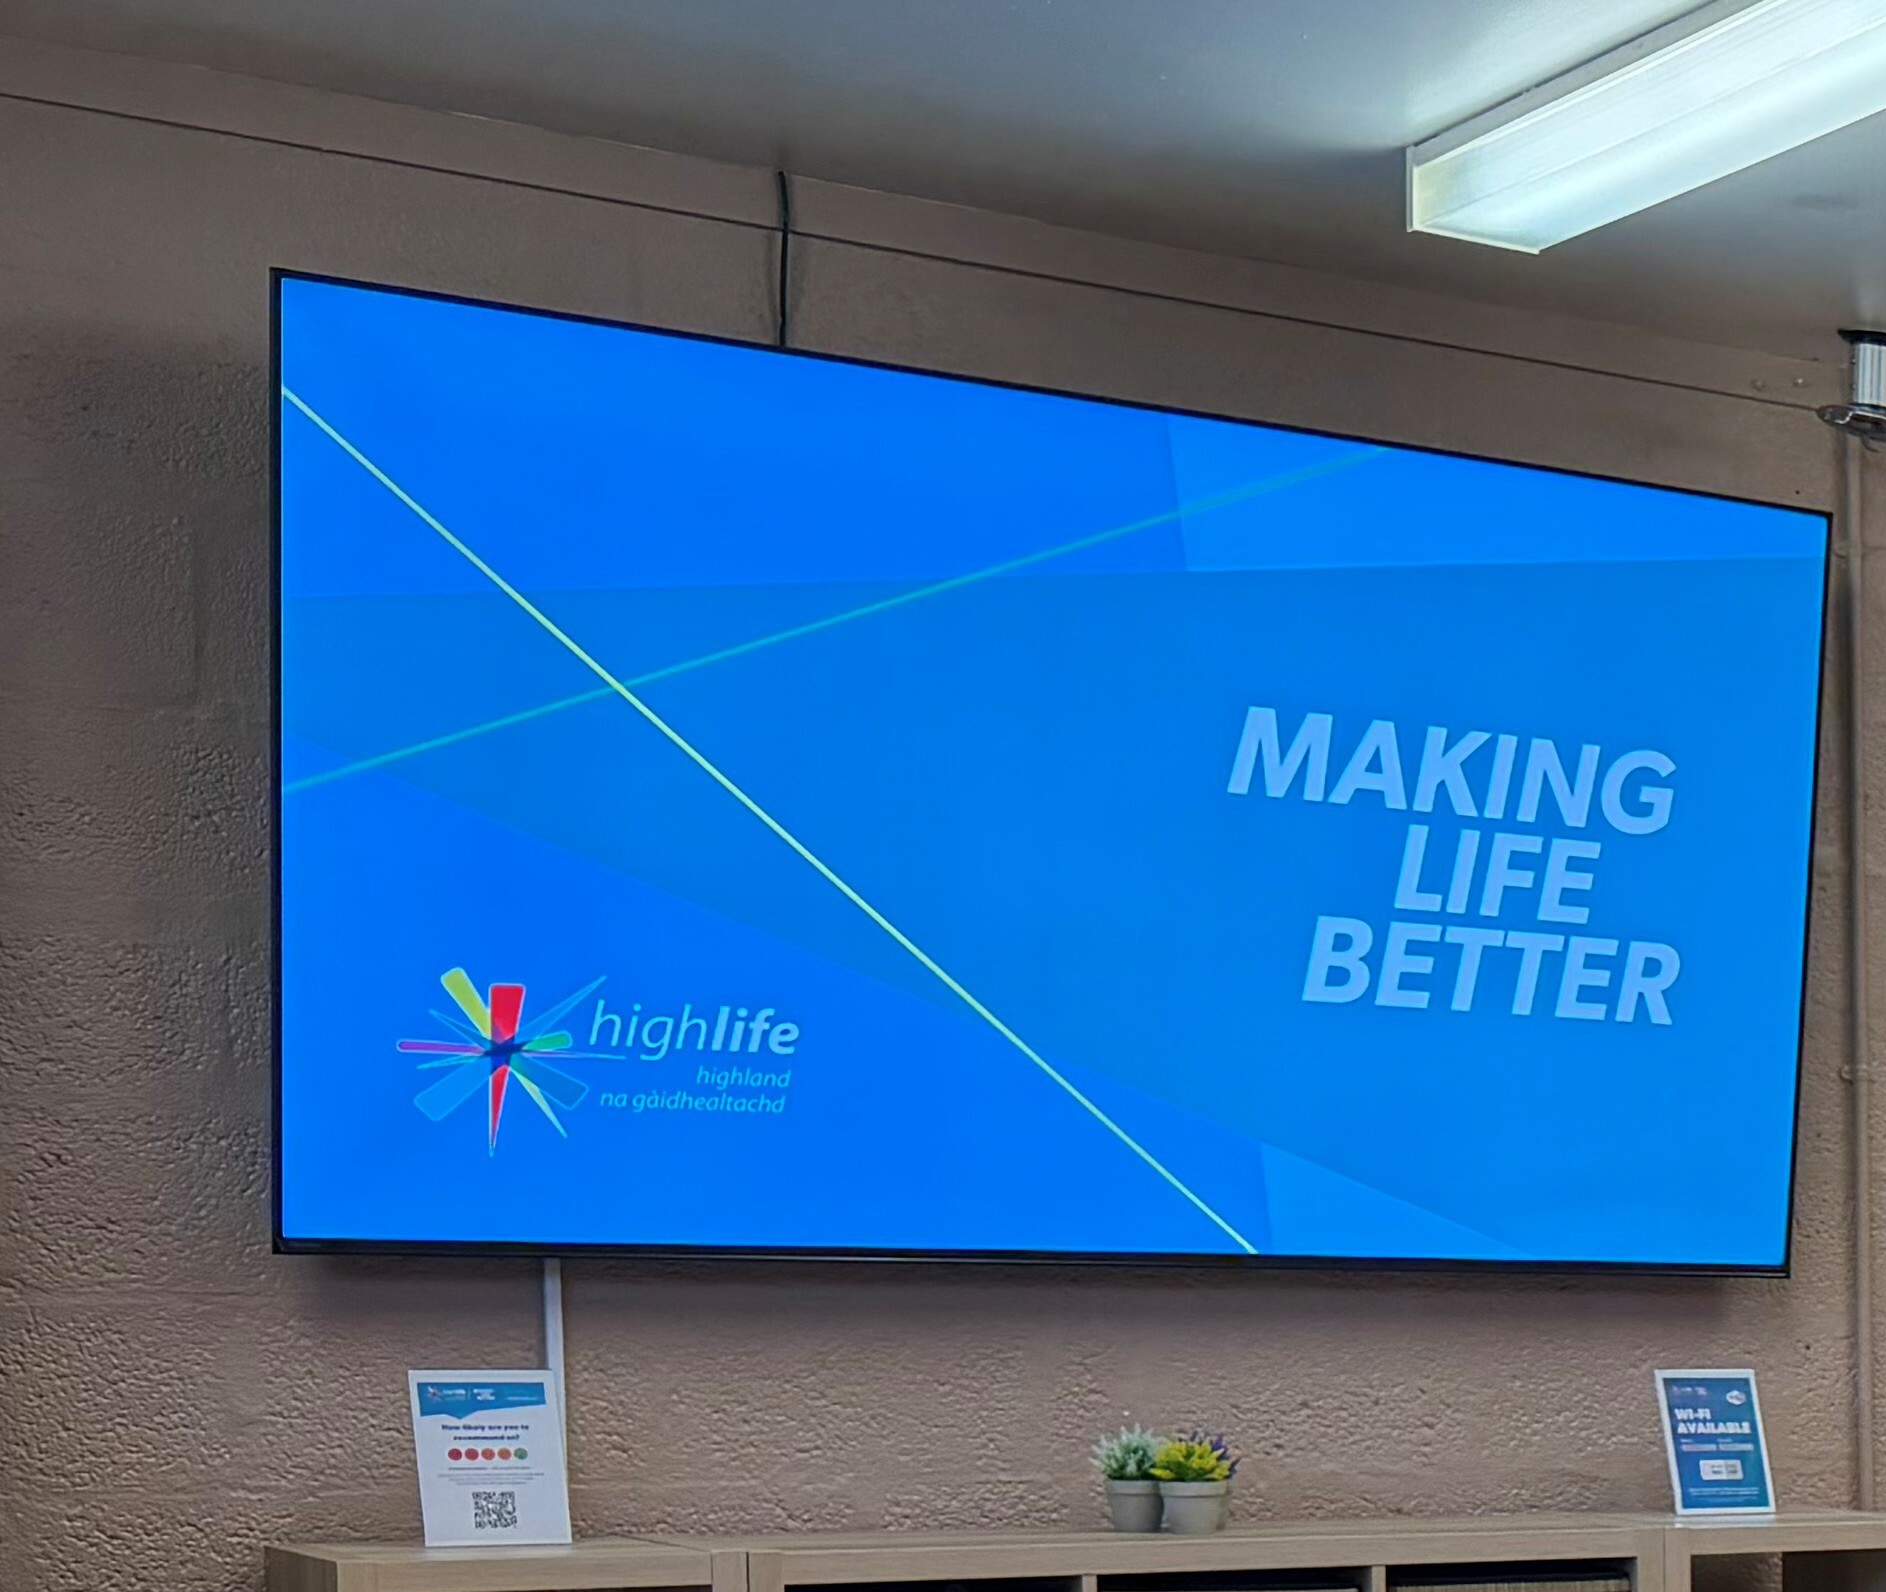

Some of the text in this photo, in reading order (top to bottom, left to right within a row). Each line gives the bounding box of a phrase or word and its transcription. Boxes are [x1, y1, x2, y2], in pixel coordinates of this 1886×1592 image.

[1227, 706, 1677, 835] MAKING
[1394, 824, 1601, 924] LIFE
[1302, 915, 1681, 1025] BETTER
[589, 999, 799, 1061] highlife
[696, 1065, 792, 1091] highland
[600, 1090, 785, 1113] na gàidhealtachd
[1674, 1408, 1711, 1420] WI-FI
[1677, 1422, 1751, 1433] AVAILABLE
